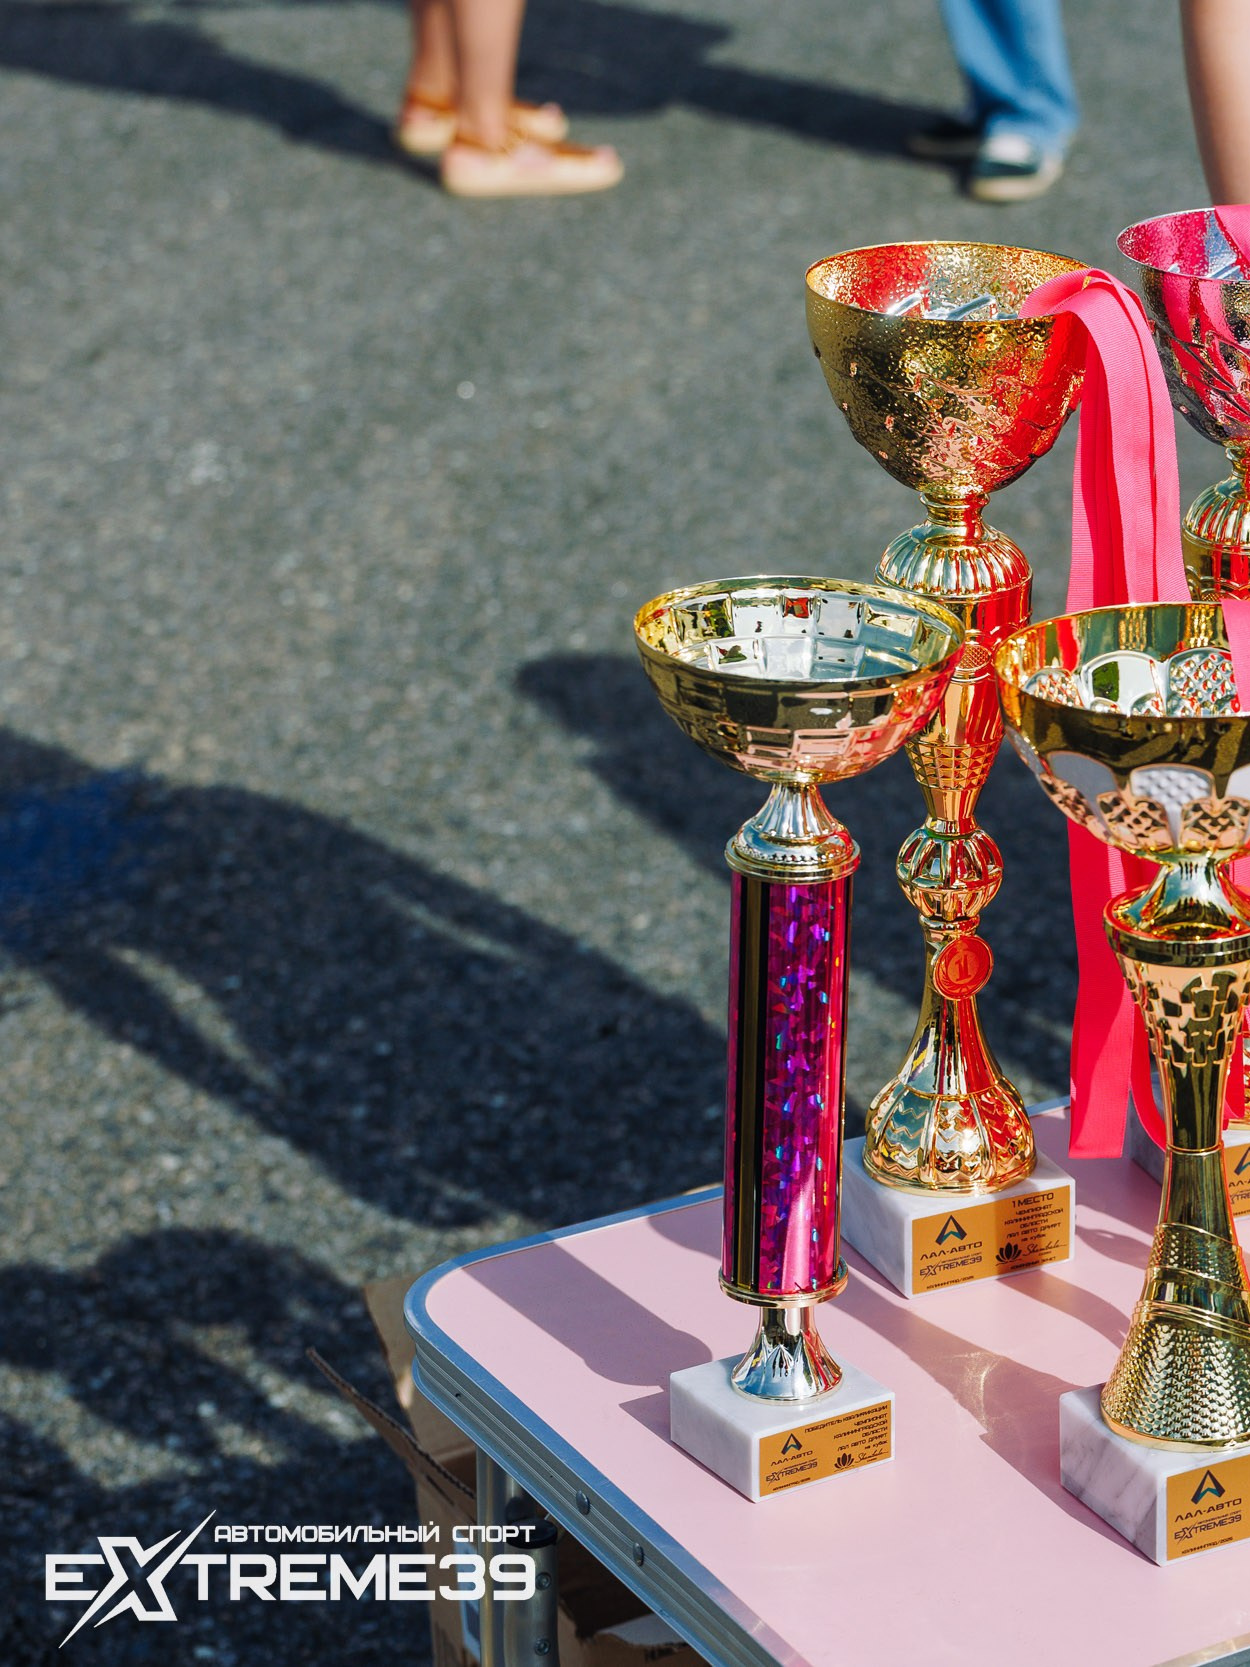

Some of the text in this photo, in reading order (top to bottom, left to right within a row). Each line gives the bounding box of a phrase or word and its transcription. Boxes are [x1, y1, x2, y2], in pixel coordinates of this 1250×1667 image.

[955, 954, 972, 982] 1
[1011, 1192, 1054, 1209] 1 МЕСТО
[919, 1255, 983, 1281] EXTREME39
[1174, 1514, 1242, 1545] EXTREME39
